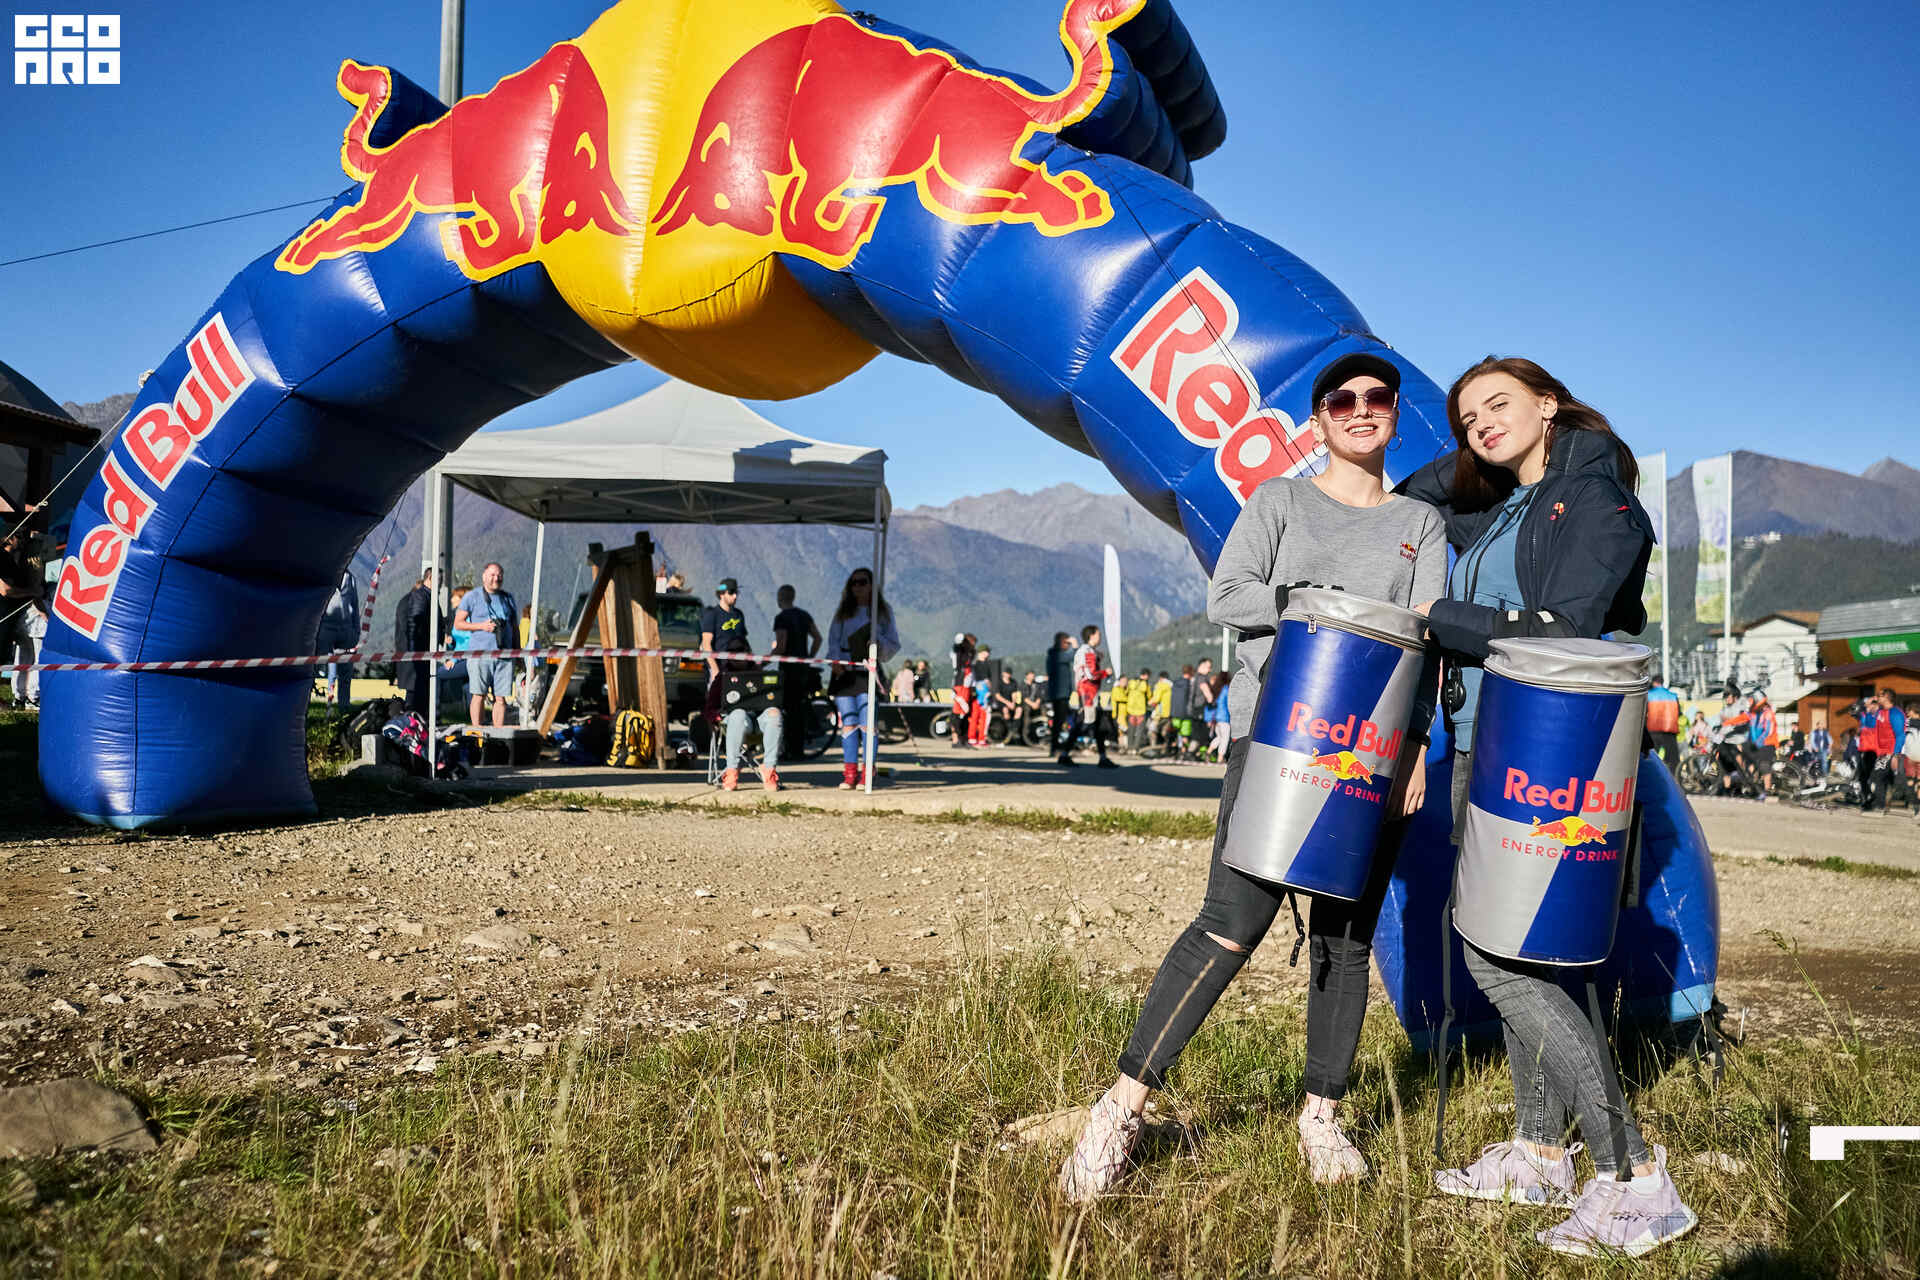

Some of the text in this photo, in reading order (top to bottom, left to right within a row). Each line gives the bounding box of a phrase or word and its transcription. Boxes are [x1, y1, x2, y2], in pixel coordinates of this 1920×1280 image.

[1118, 277, 1318, 501] Red
[53, 321, 247, 634] Red Bull
[1287, 701, 1403, 760] Red Bull
[1280, 767, 1341, 792] ENERGY
[1503, 767, 1635, 813] Red Bull
[1501, 838, 1570, 860] ENERGY
